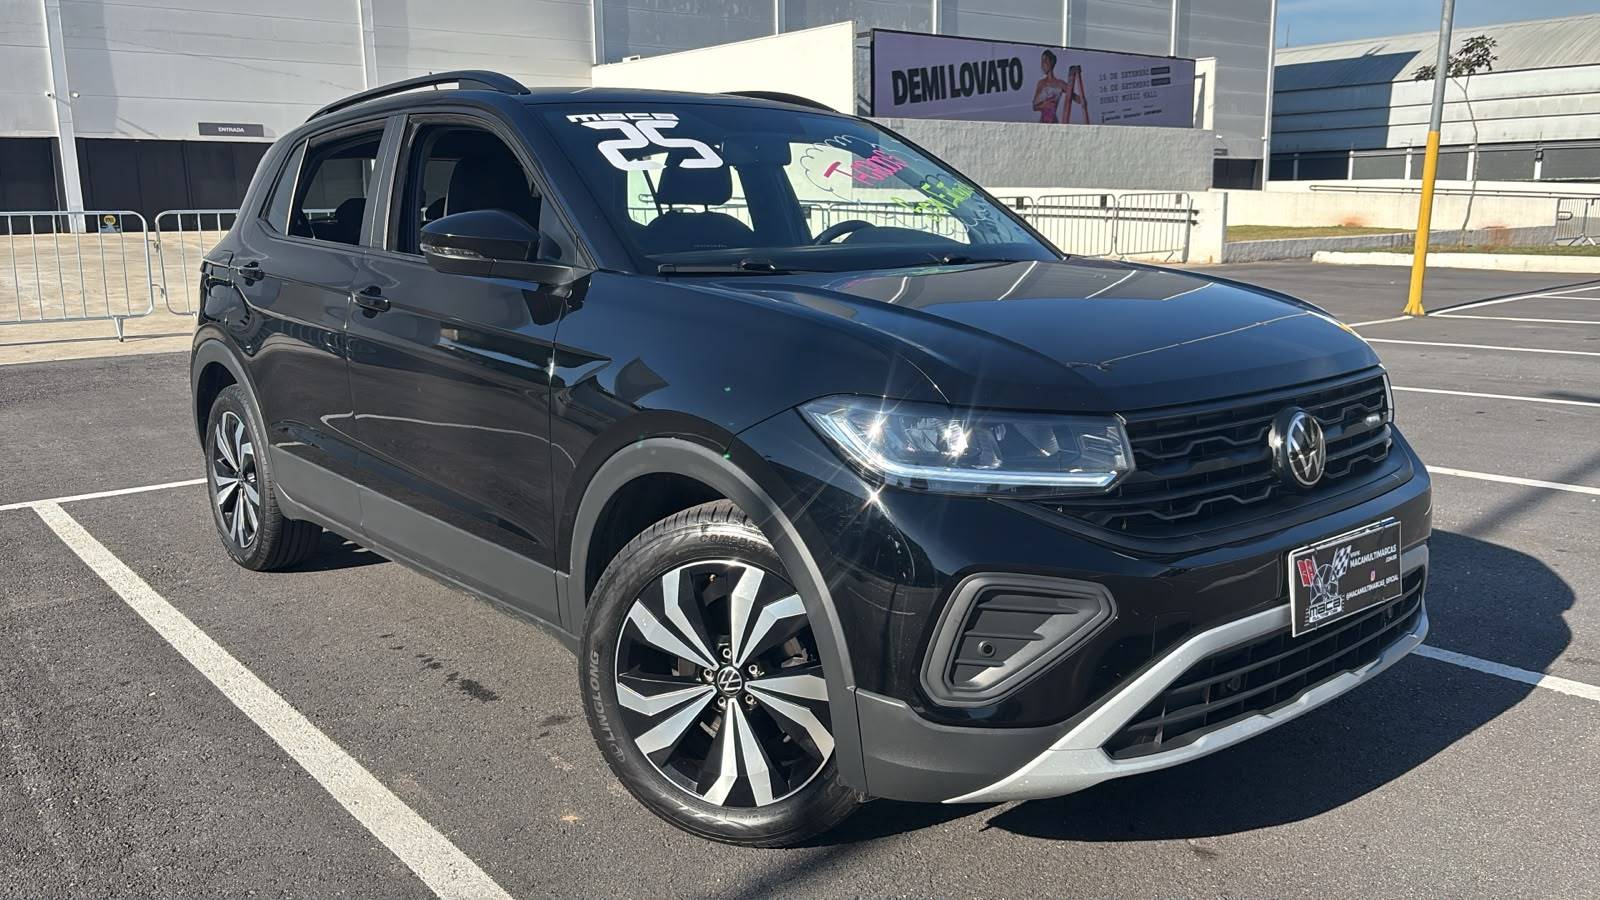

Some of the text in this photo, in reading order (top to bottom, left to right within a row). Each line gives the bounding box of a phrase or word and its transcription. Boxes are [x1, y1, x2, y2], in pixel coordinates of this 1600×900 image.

[892, 57, 1023, 106] DEMI LOVATO
[580, 120, 724, 171] 25
[589, 649, 616, 741] LINGLONG
